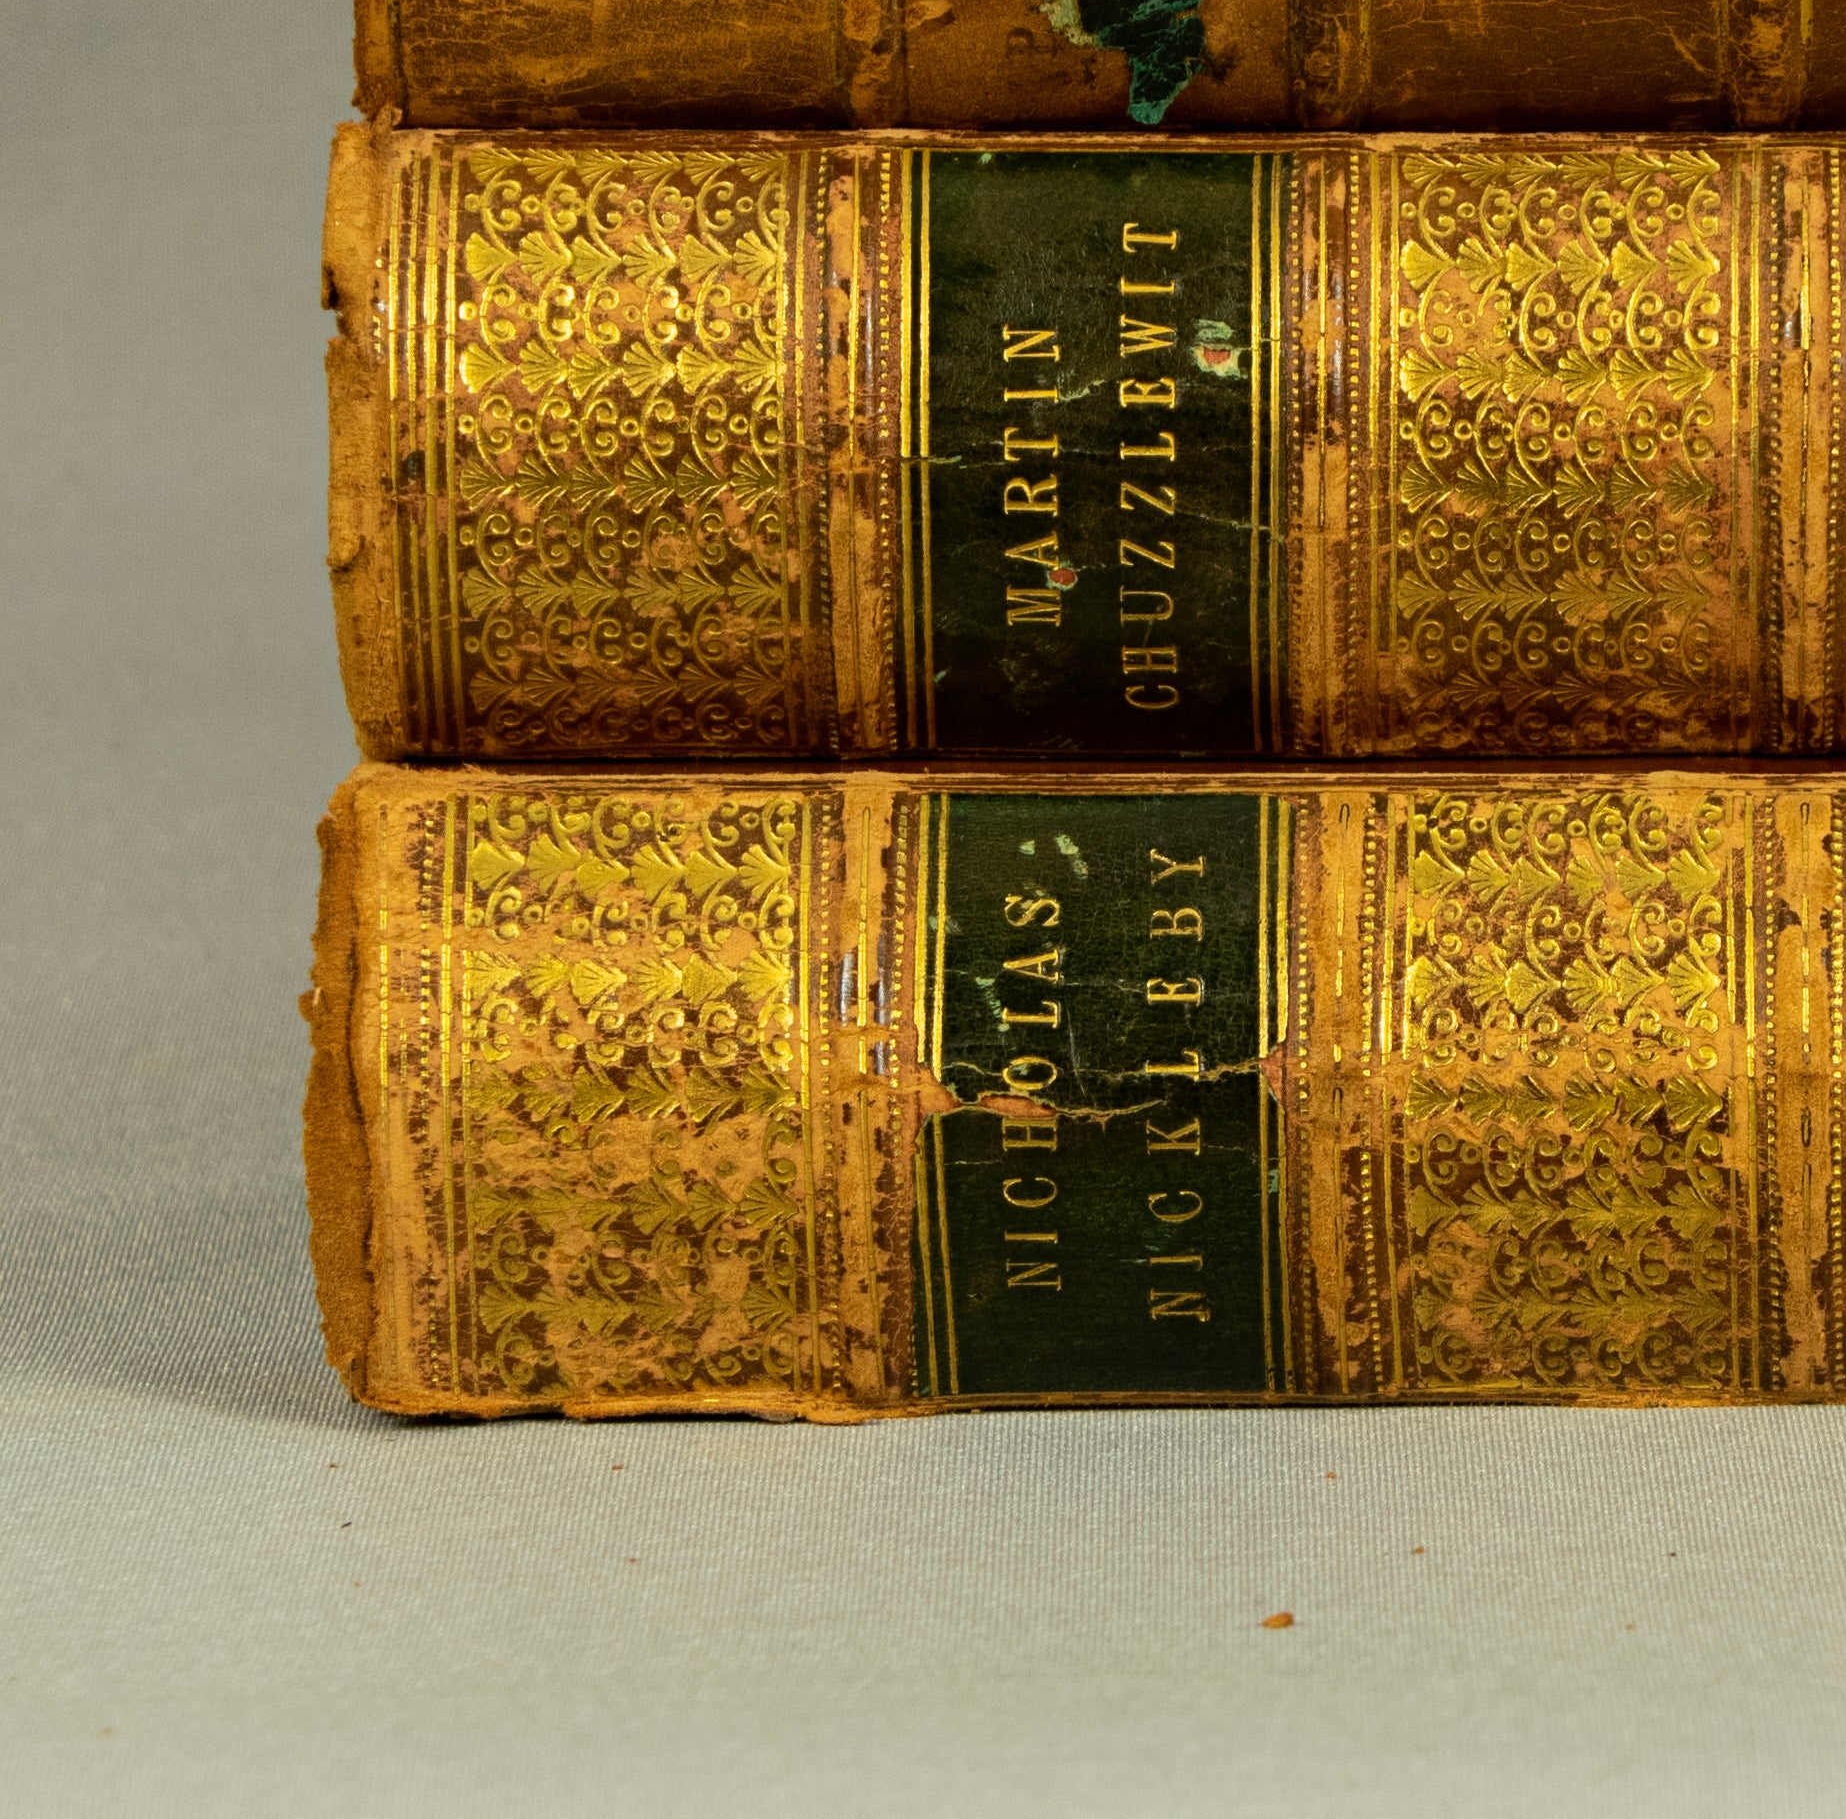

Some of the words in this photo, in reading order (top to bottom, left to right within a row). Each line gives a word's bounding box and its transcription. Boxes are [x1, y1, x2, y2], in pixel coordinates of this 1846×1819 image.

[1003, 324, 1062, 628] MARTIN
[1120, 221, 1180, 710] CHUZZLEWIT
[1002, 894, 1062, 1292] NICHOLAS
[1146, 848, 1211, 1322] NICKLEBY
